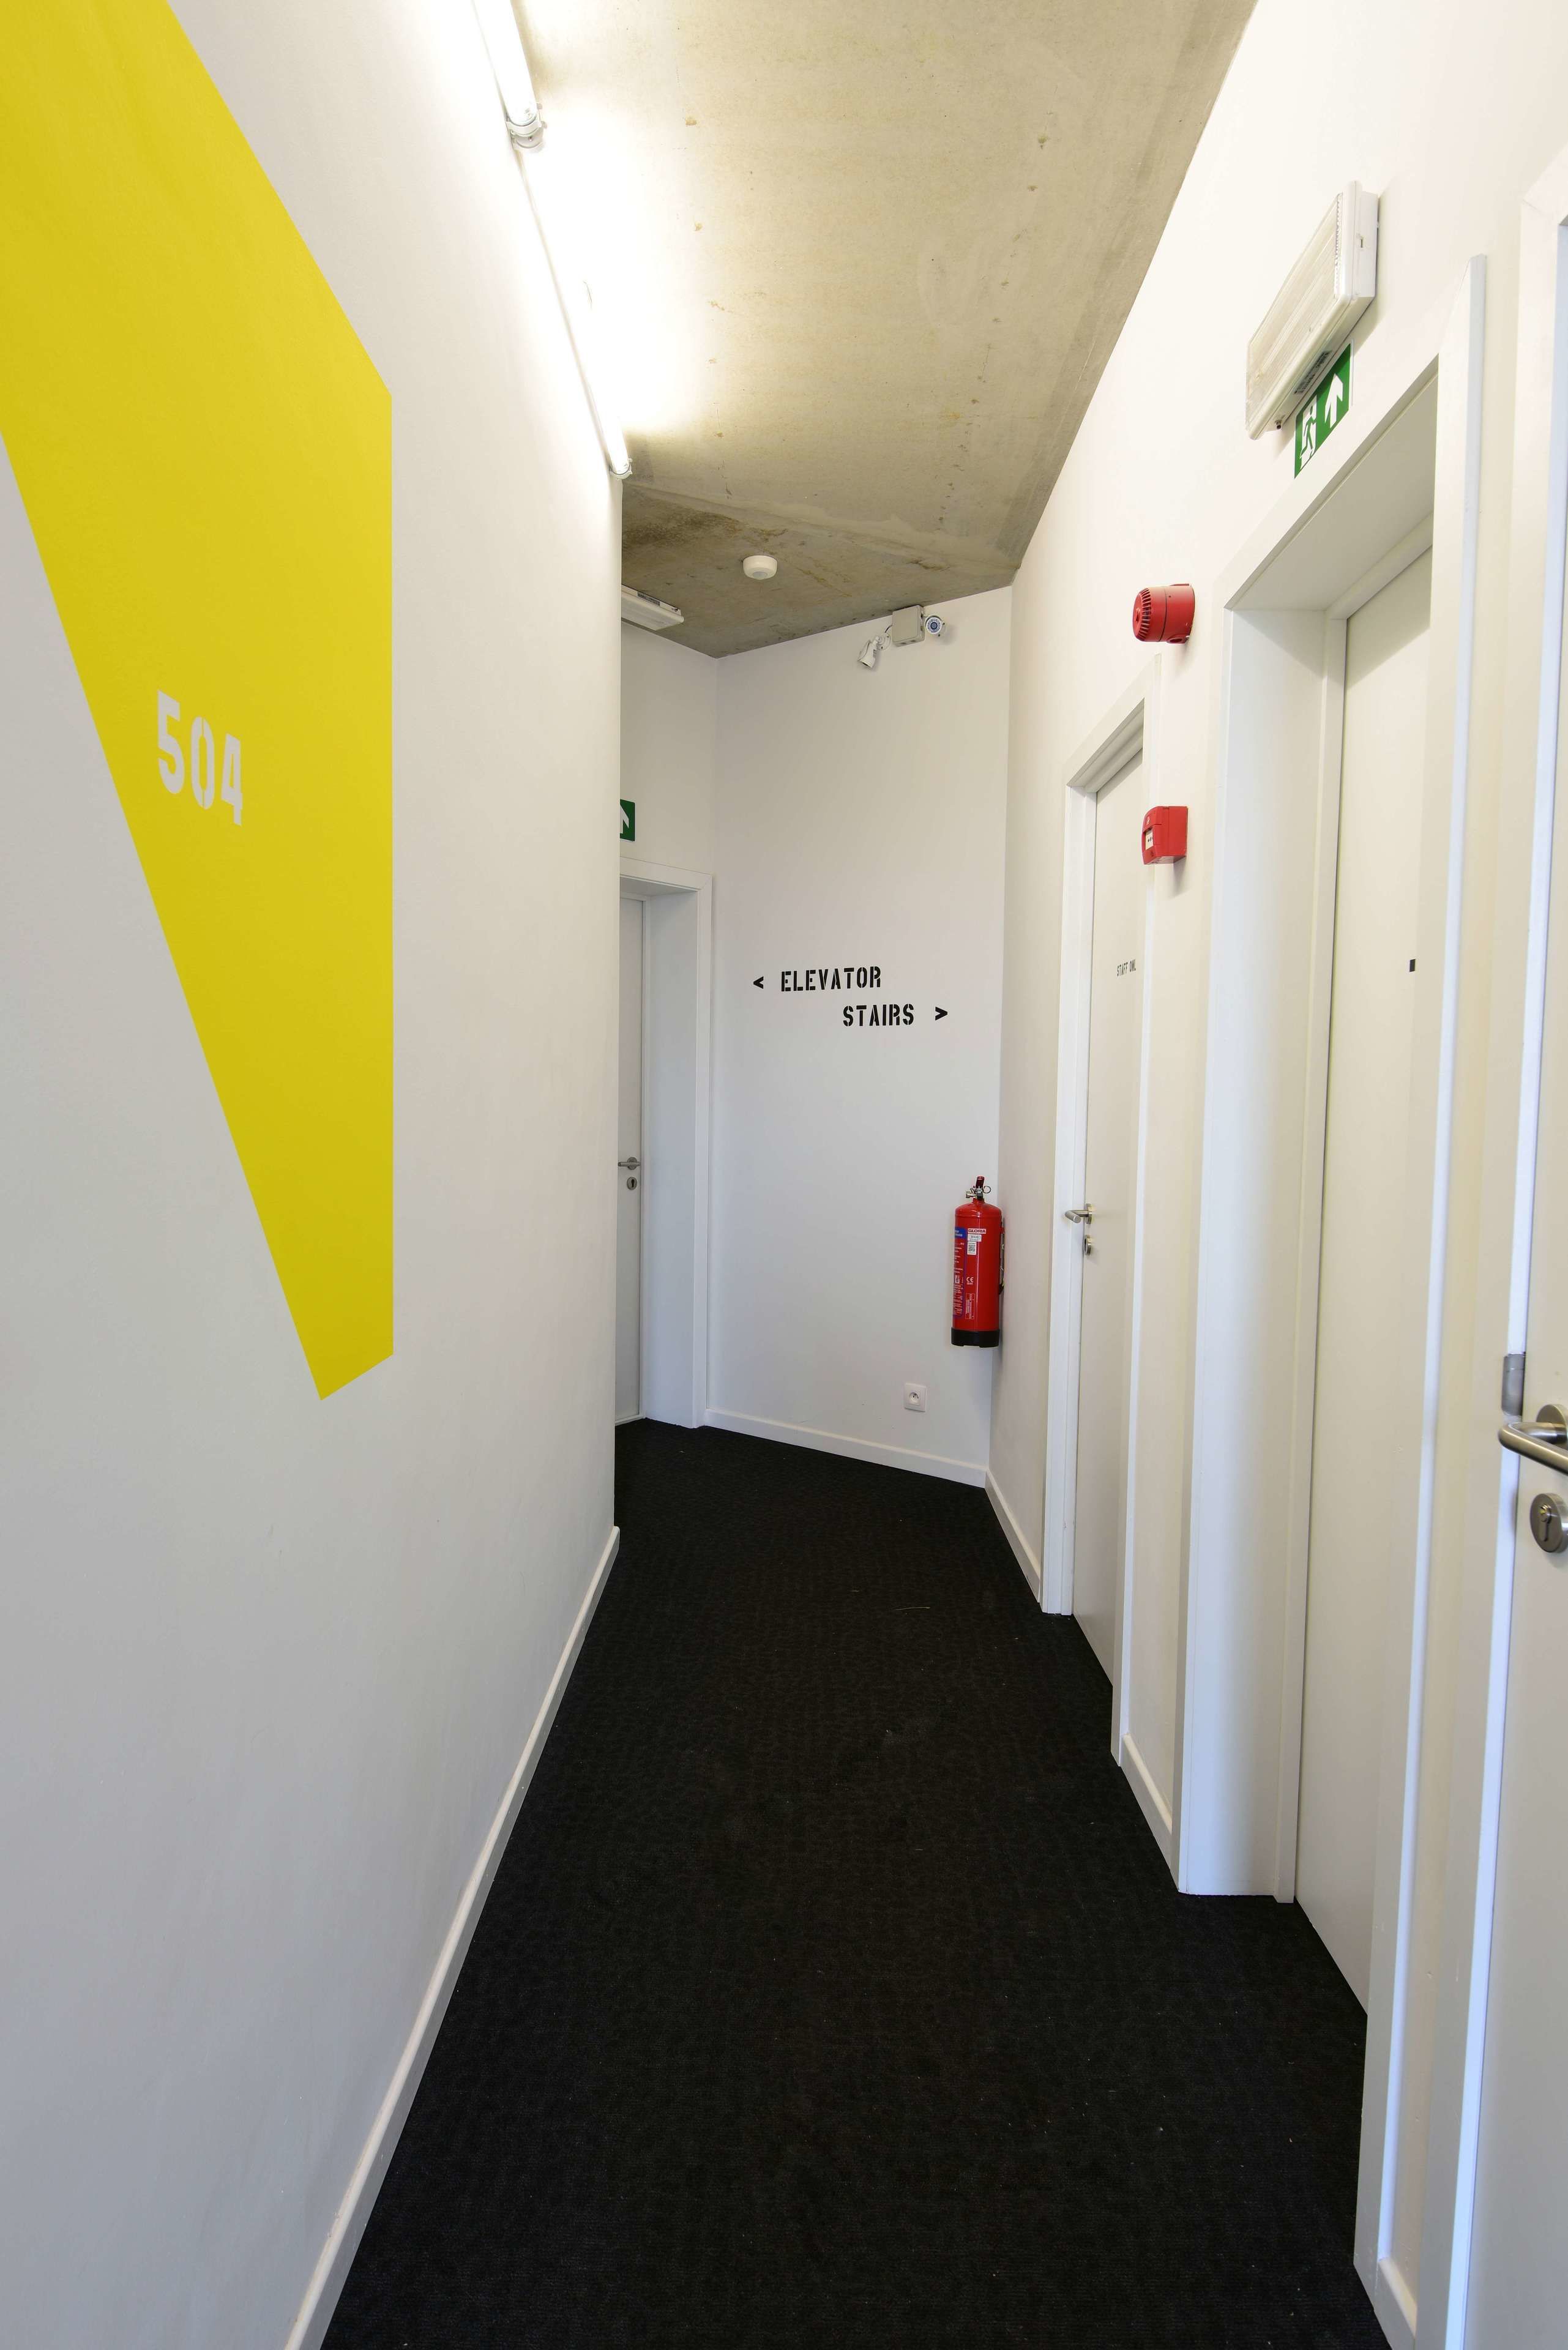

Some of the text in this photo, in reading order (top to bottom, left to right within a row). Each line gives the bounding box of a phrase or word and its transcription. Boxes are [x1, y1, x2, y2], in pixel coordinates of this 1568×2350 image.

[157, 689, 242, 826] 504
[781, 966, 881, 991] ELEVATOR
[1117, 962, 1128, 976] STAFF
[843, 1004, 914, 1027] STAIRS
